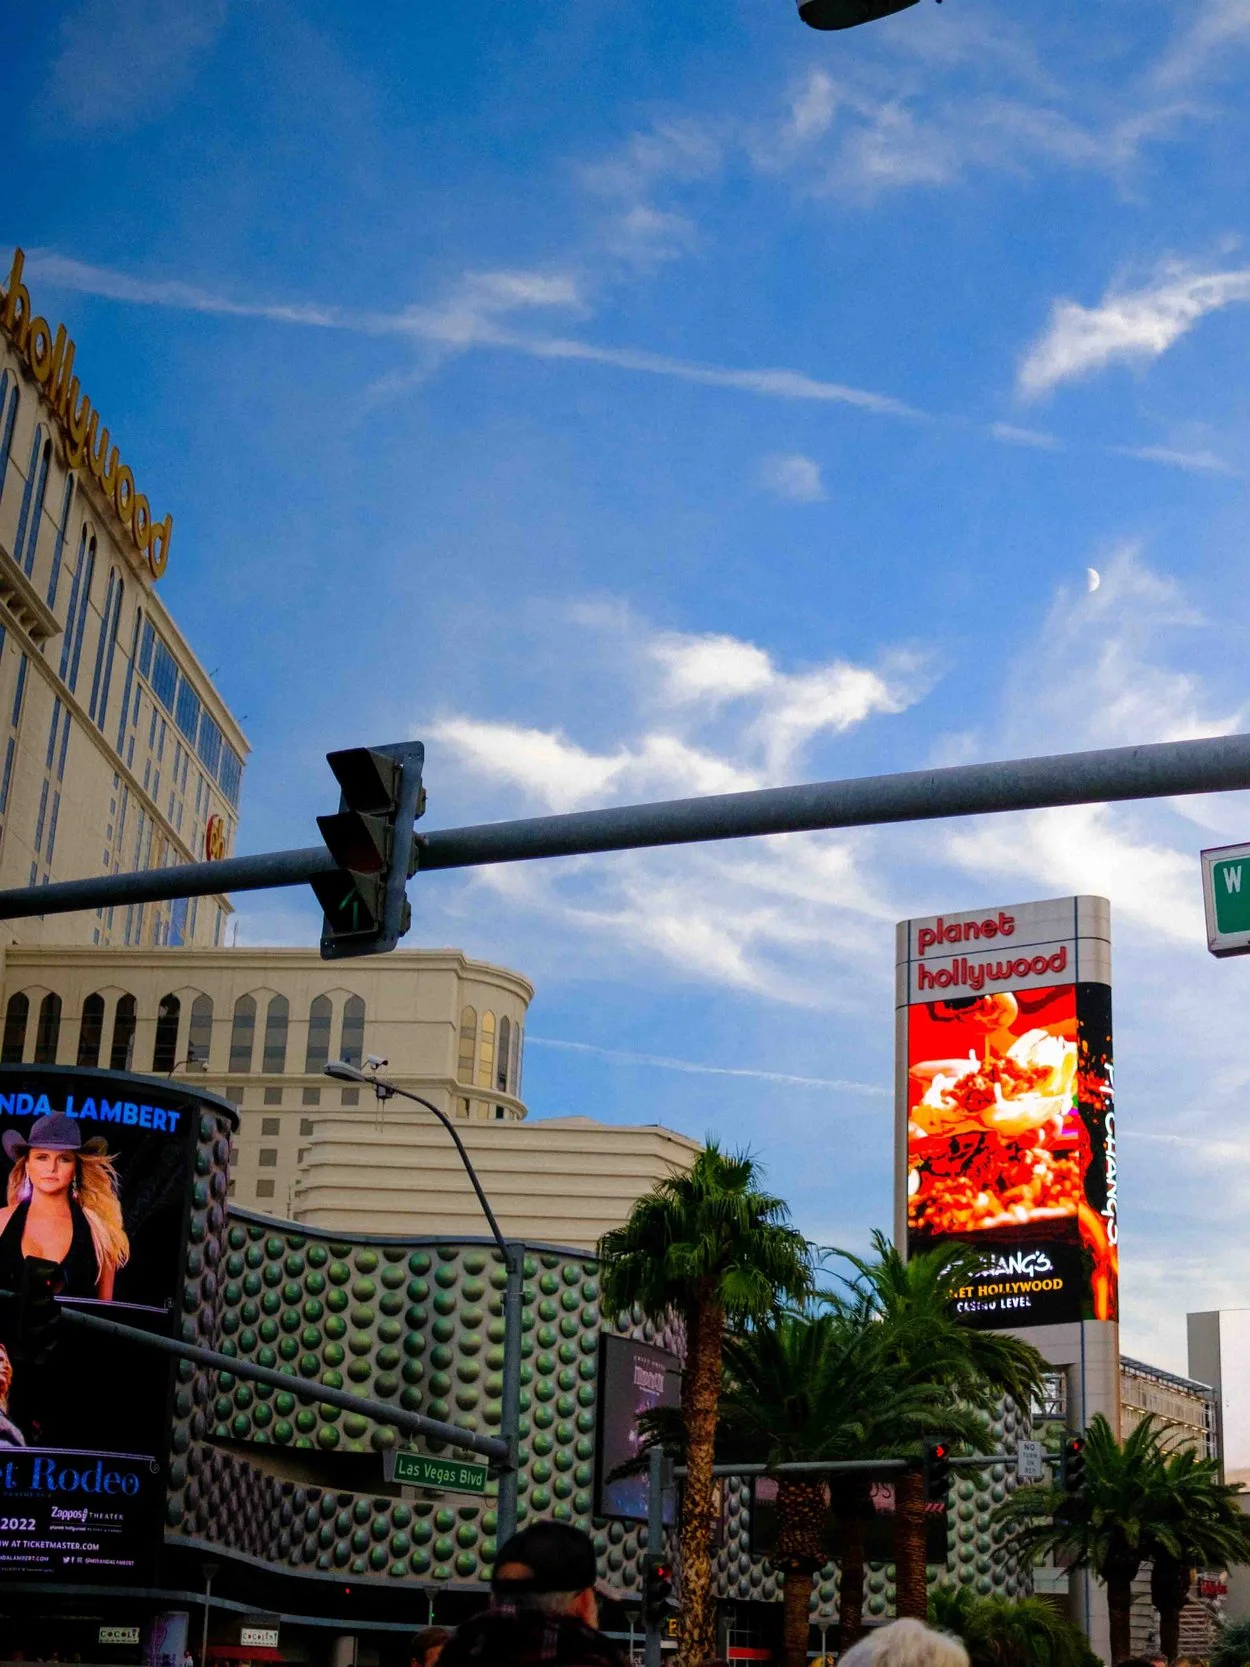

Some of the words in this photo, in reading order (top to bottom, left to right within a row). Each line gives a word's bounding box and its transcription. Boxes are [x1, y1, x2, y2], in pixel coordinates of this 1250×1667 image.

[6, 246, 173, 580] hollywood
[1222, 865, 1243, 894] W
[917, 912, 1015, 955] planet
[917, 946, 1067, 991] hollywood
[66, 1095, 181, 1133] LAMBERT
[978, 1278, 1063, 1297] HOLLYWOOD
[1000, 1296, 1032, 1309] LEVEL
[1024, 1443, 1036, 1451] NO
[28, 1456, 140, 1496] Rodeo
[398, 1459, 420, 1476] Las
[424, 1463, 456, 1484] Vegas
[459, 1469, 483, 1486] Blvd
[0, 1517, 36, 1531] 2022
[51, 1506, 82, 1521] Zappos
[89, 1511, 124, 1521] THEATER
[11, 1540, 21, 1548] AT
[23, 1540, 100, 1551] TICKETMASTER.COM
